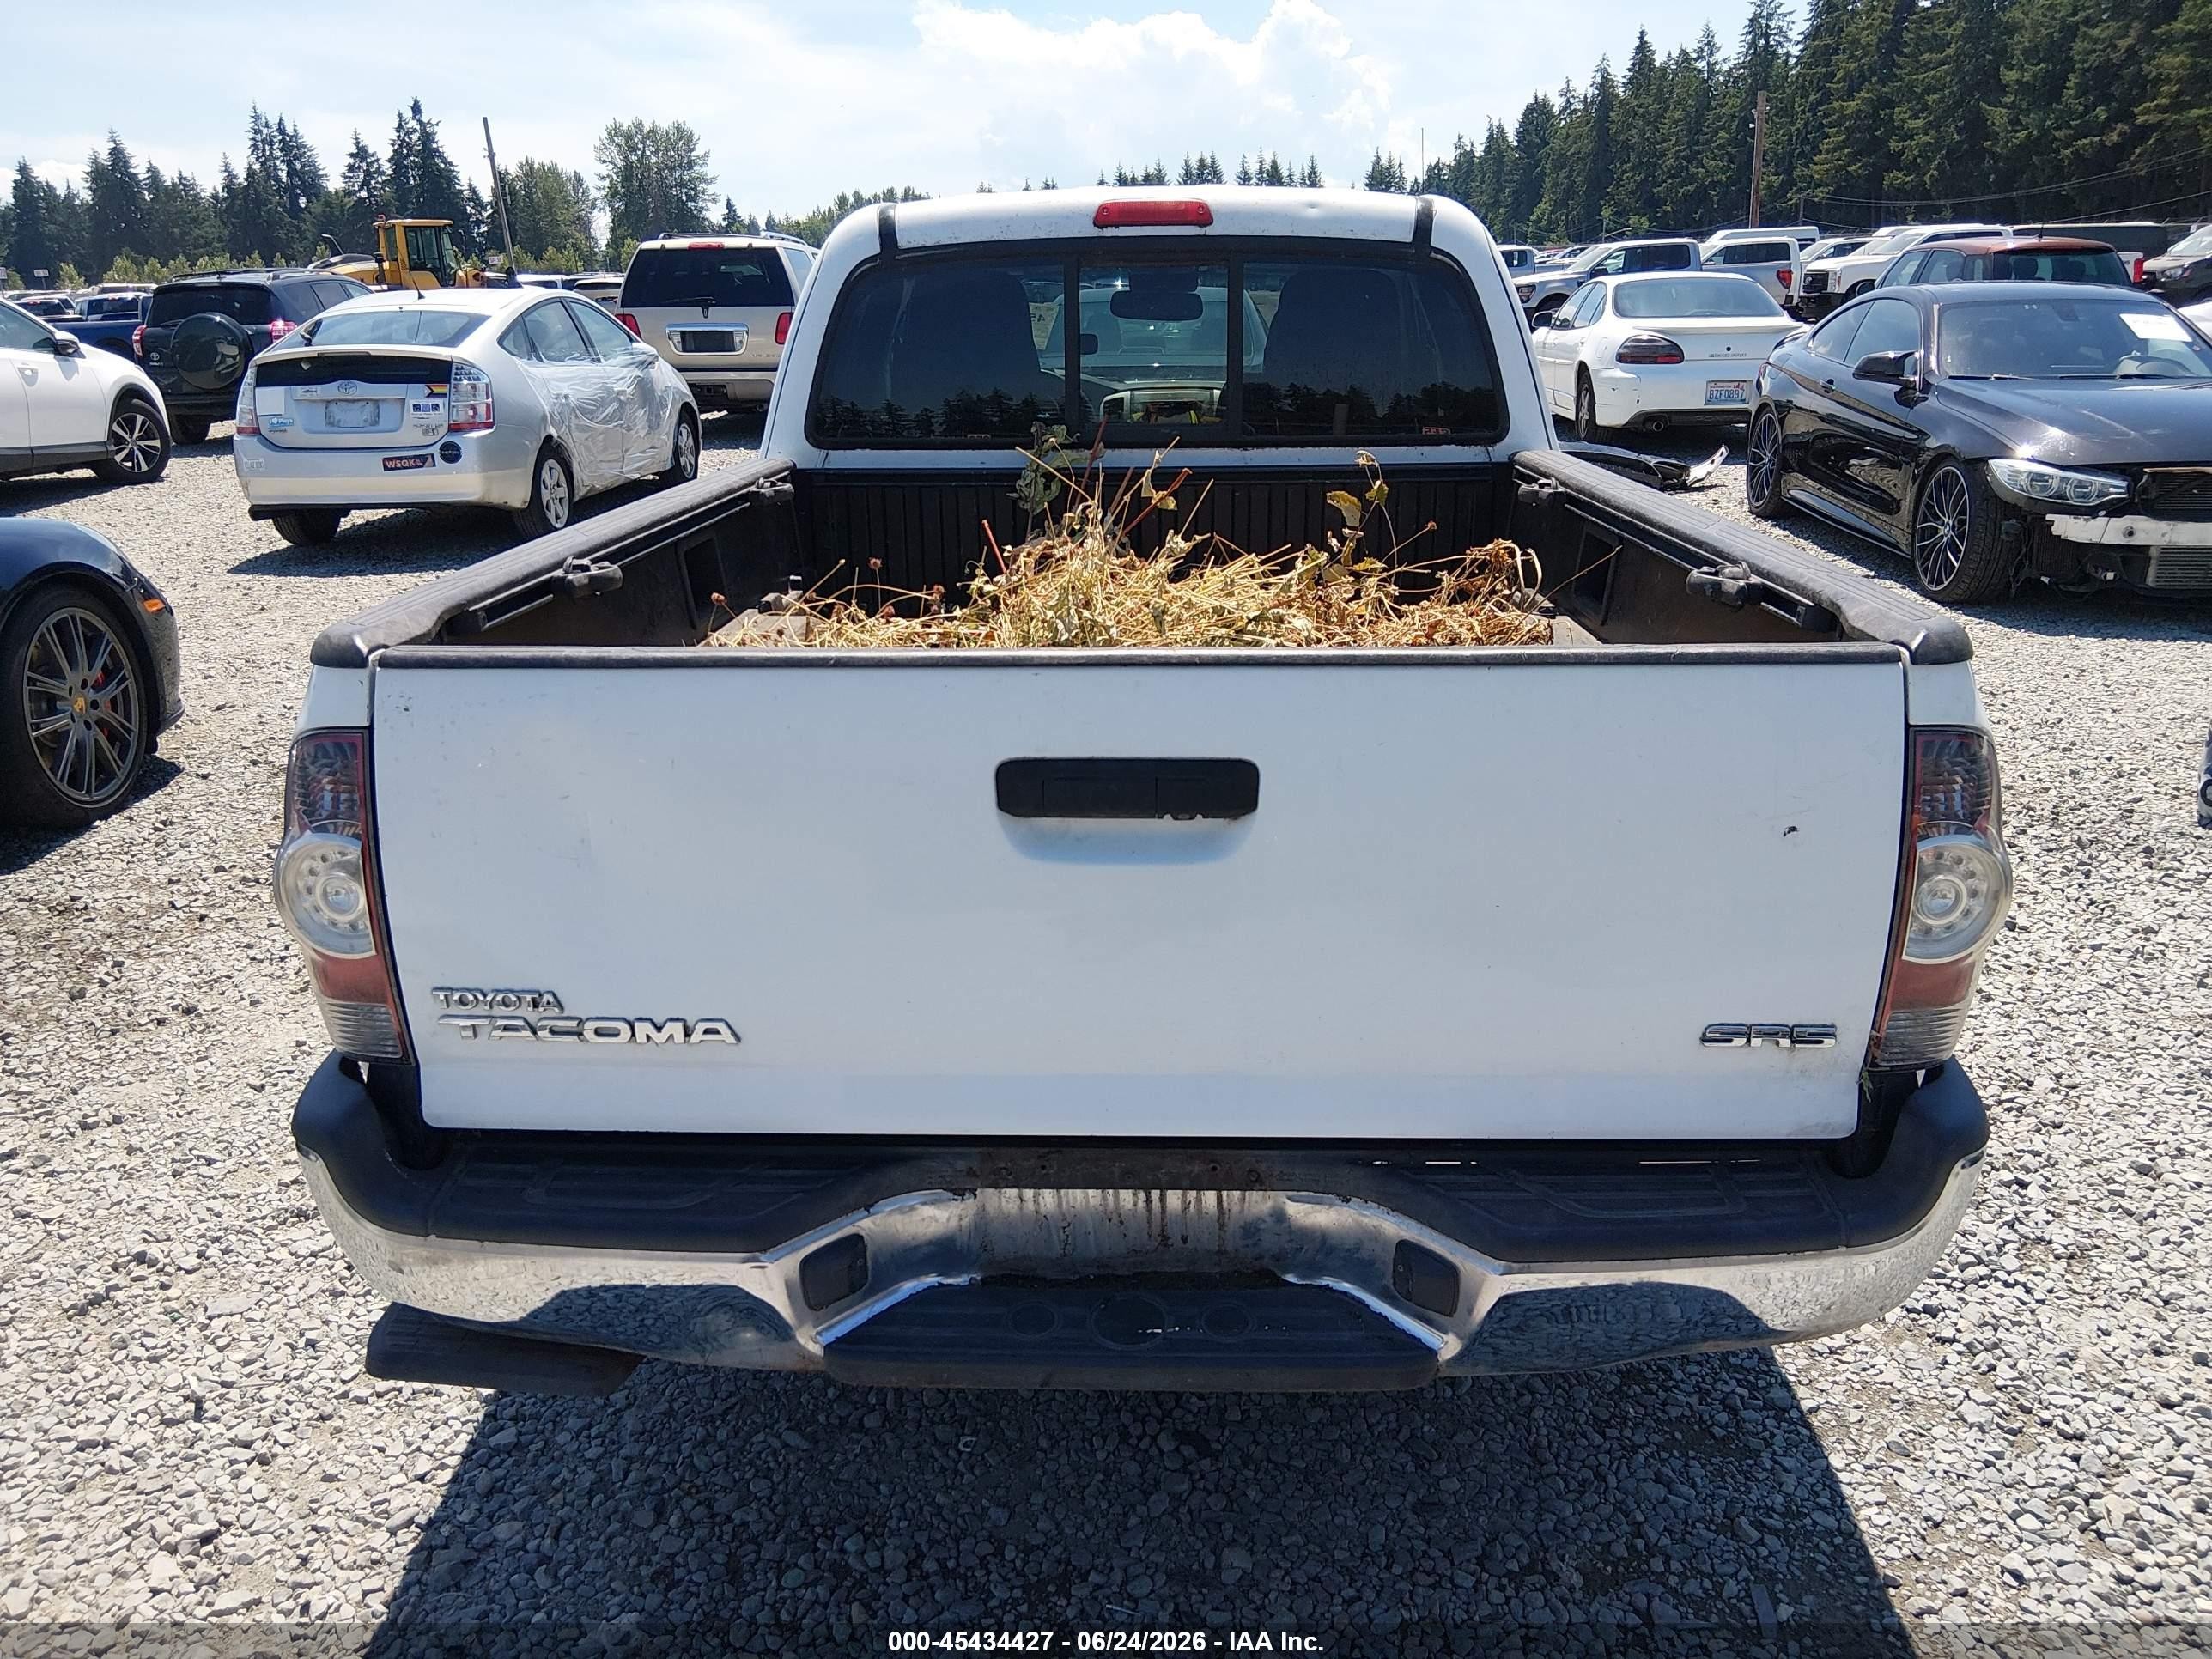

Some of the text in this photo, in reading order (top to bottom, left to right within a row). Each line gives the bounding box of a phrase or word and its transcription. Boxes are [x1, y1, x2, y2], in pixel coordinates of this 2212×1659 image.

[1709, 389, 1745, 399] BZF0897
[432, 987, 564, 1014] TOYOTA
[438, 1014, 741, 1045] TACOMA
